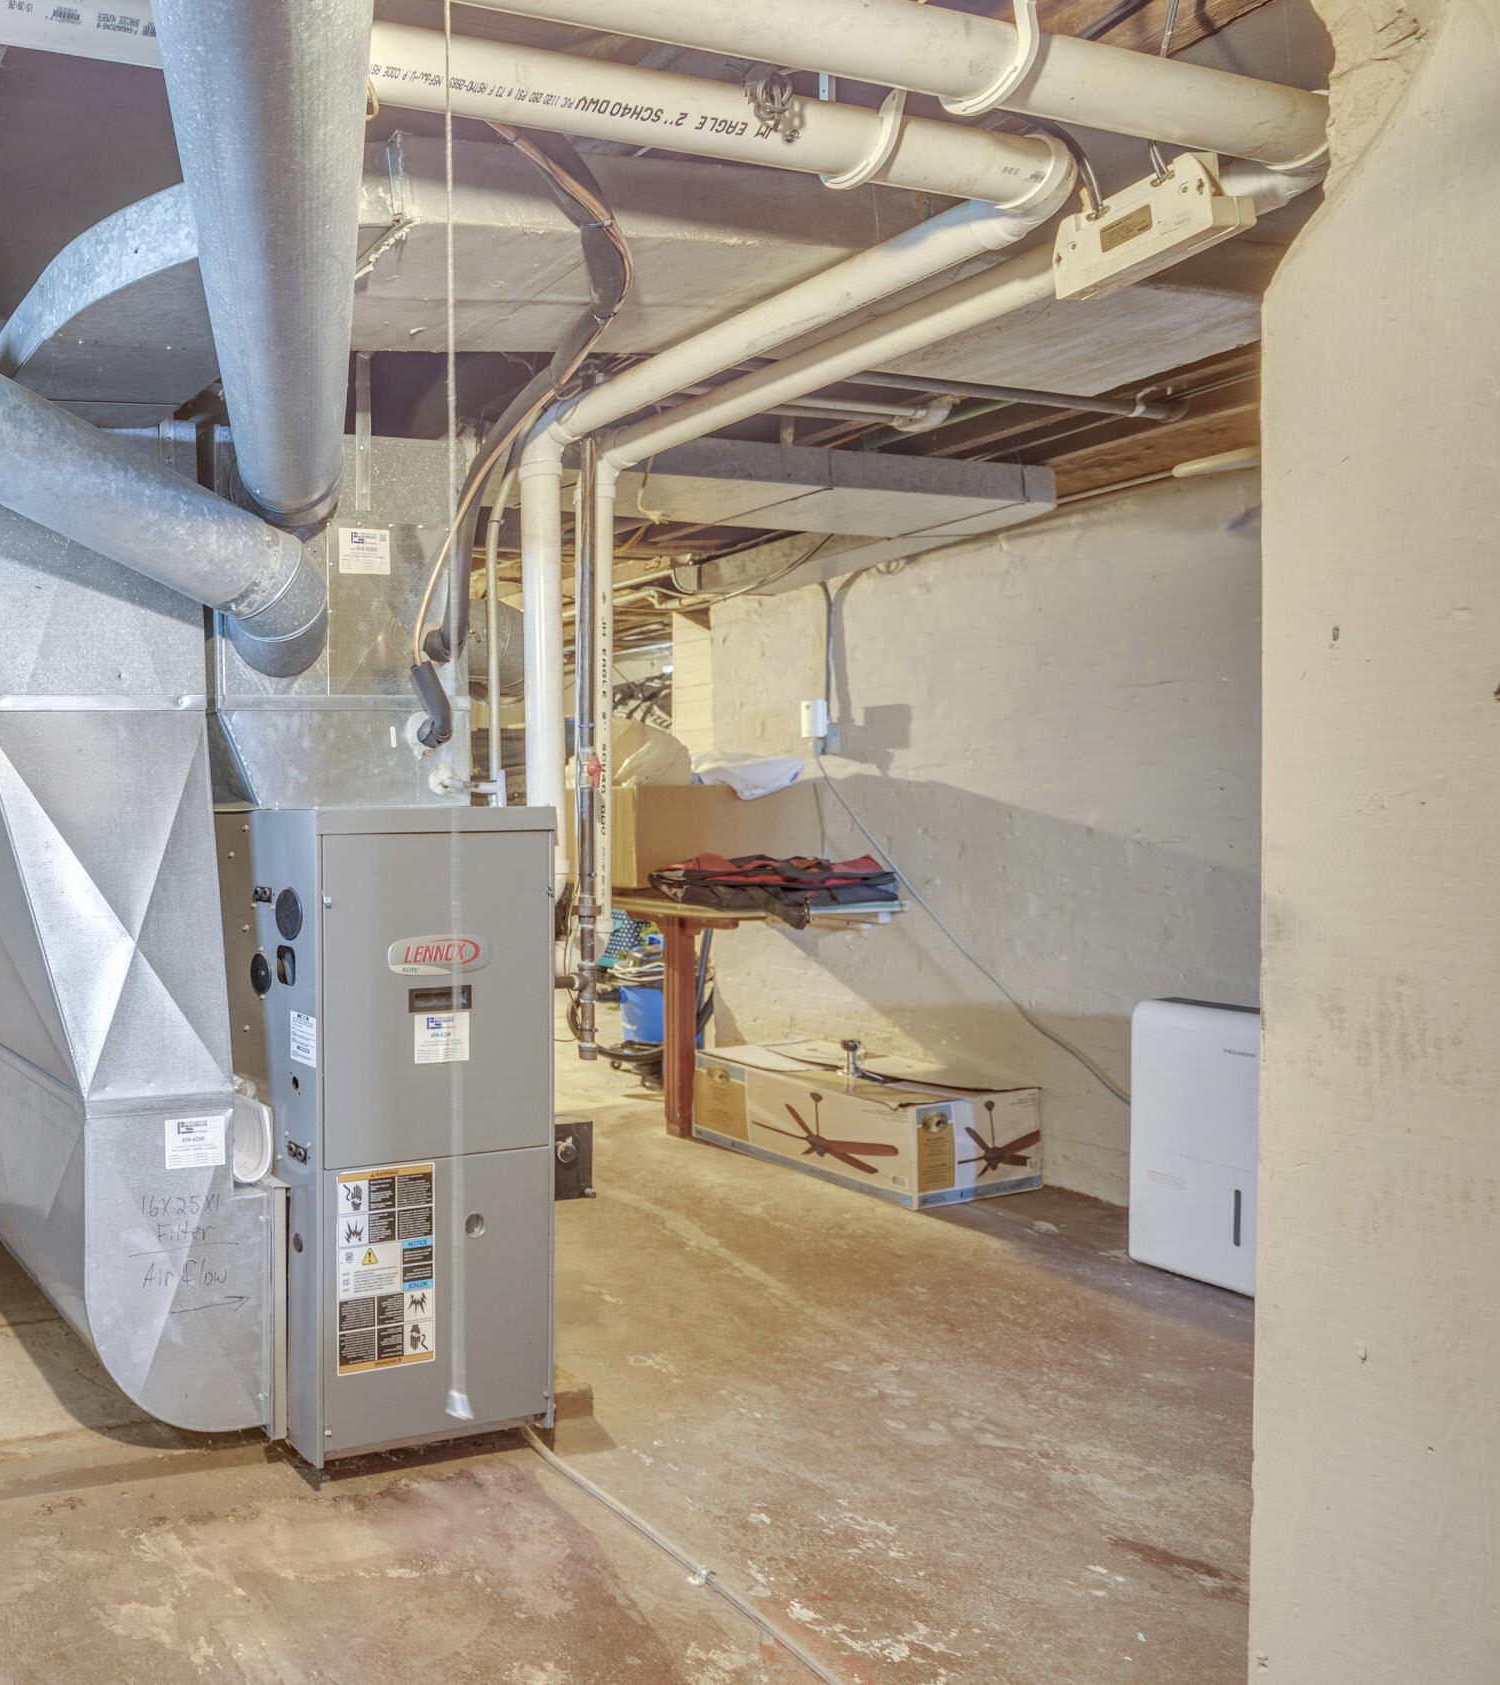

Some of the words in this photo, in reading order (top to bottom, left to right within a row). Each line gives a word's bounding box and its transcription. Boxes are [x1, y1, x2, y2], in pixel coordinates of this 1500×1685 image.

[694, 115, 749, 137] EAGLE
[404, 943, 466, 963] LENNOX
[157, 1220, 217, 1242] Filter
[142, 1262, 175, 1289] Air
